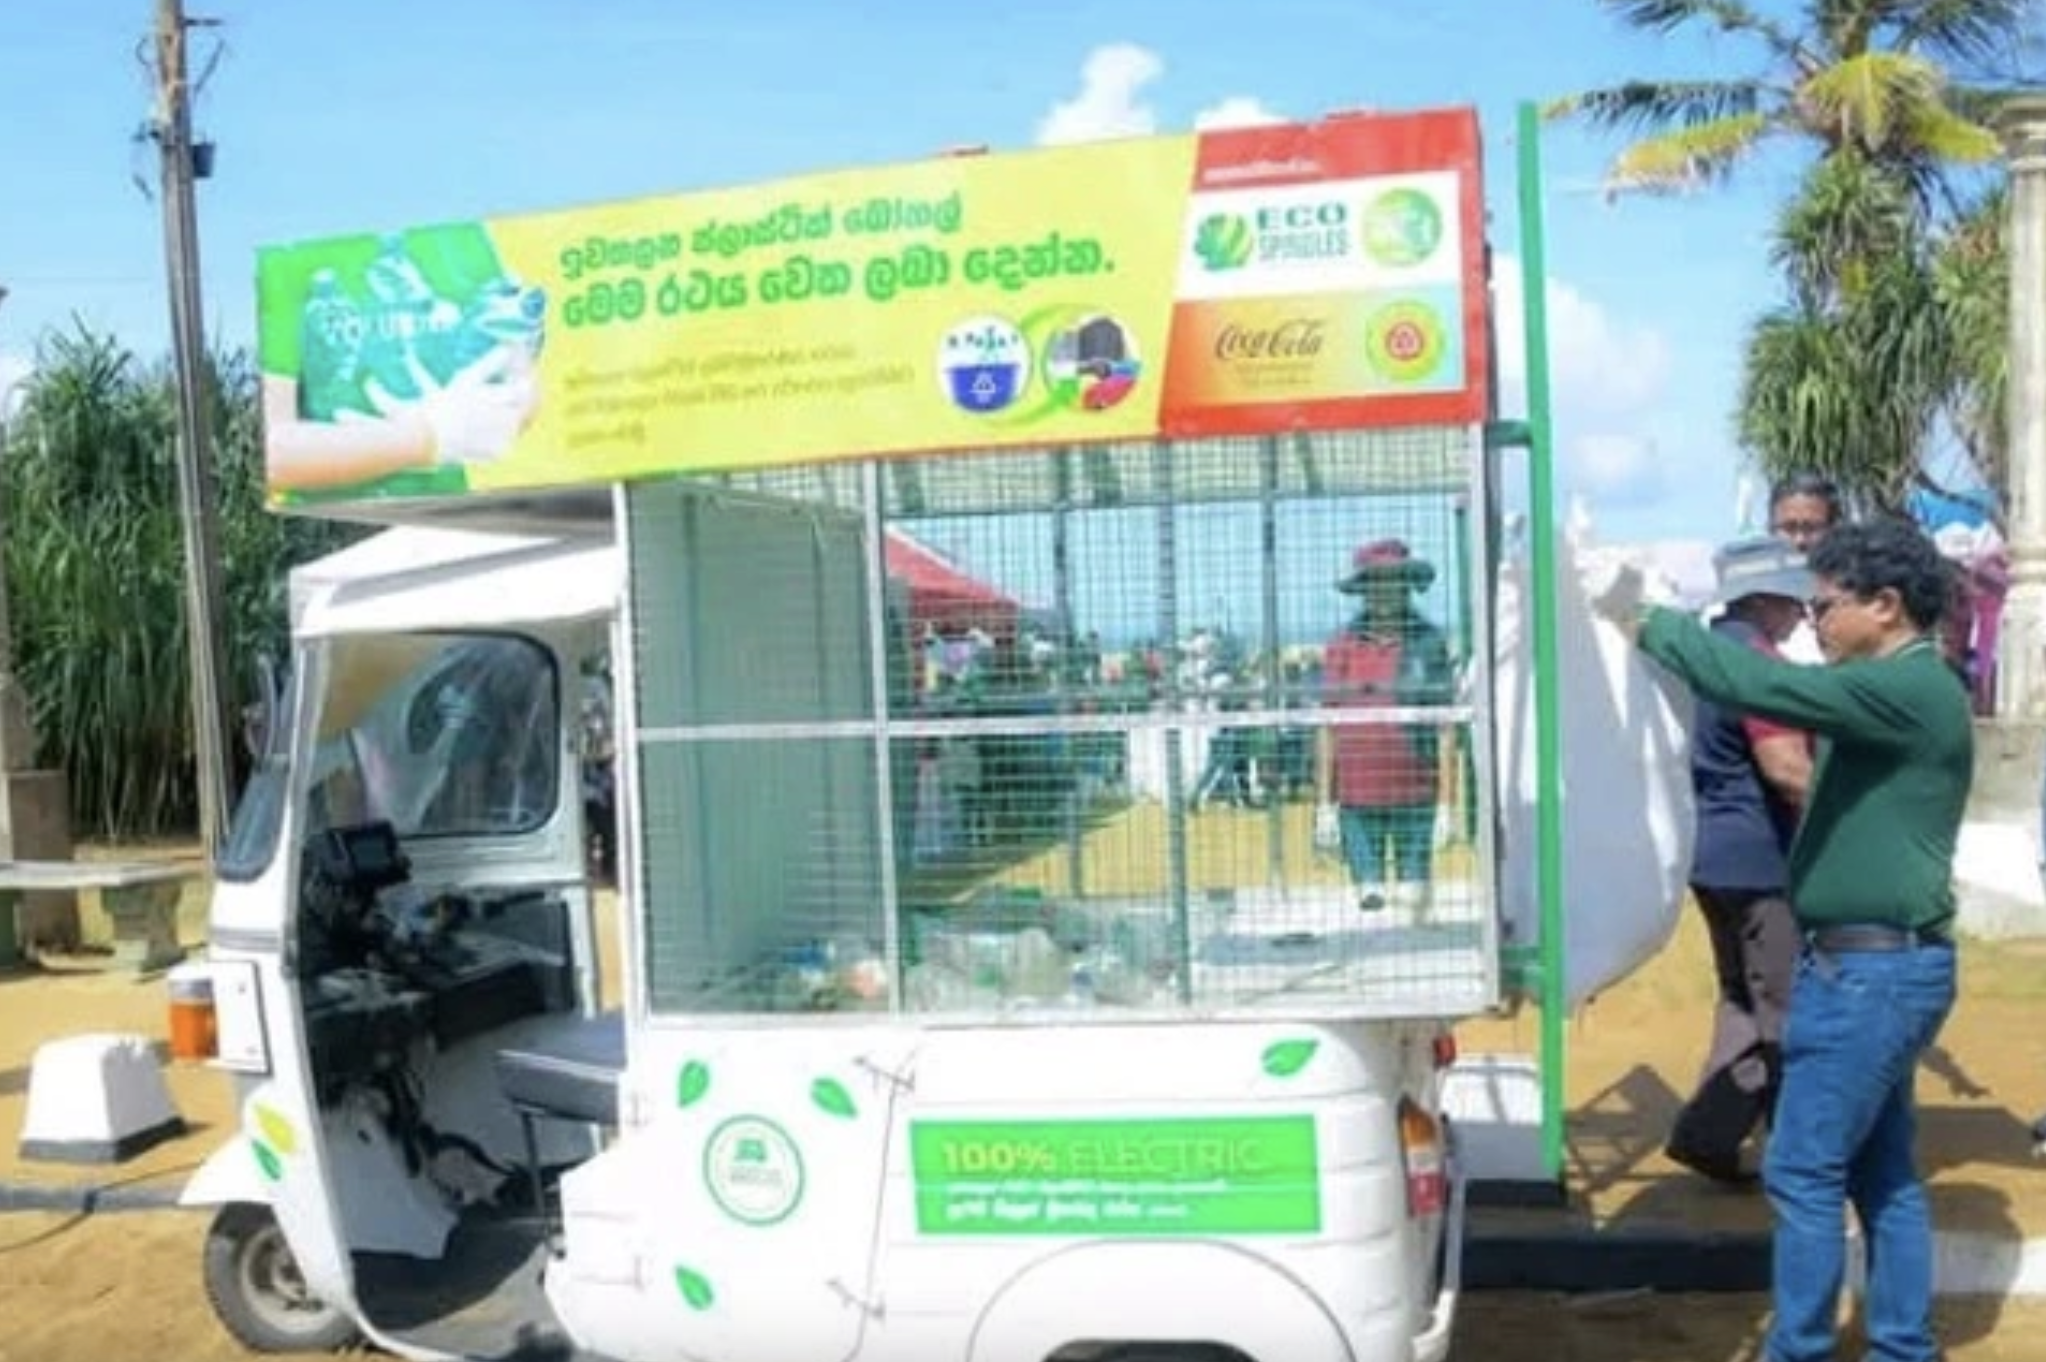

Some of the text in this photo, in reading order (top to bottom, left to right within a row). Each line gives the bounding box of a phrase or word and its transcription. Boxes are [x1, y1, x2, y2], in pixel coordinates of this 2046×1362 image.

[1257, 203, 1347, 231] ECO
[563, 275, 645, 328] මෙම
[656, 270, 748, 316] රථය
[759, 254, 851, 303] වෙත
[865, 243, 951, 302] ලබා
[942, 1138, 1267, 1173] 100% ELECTRIC
